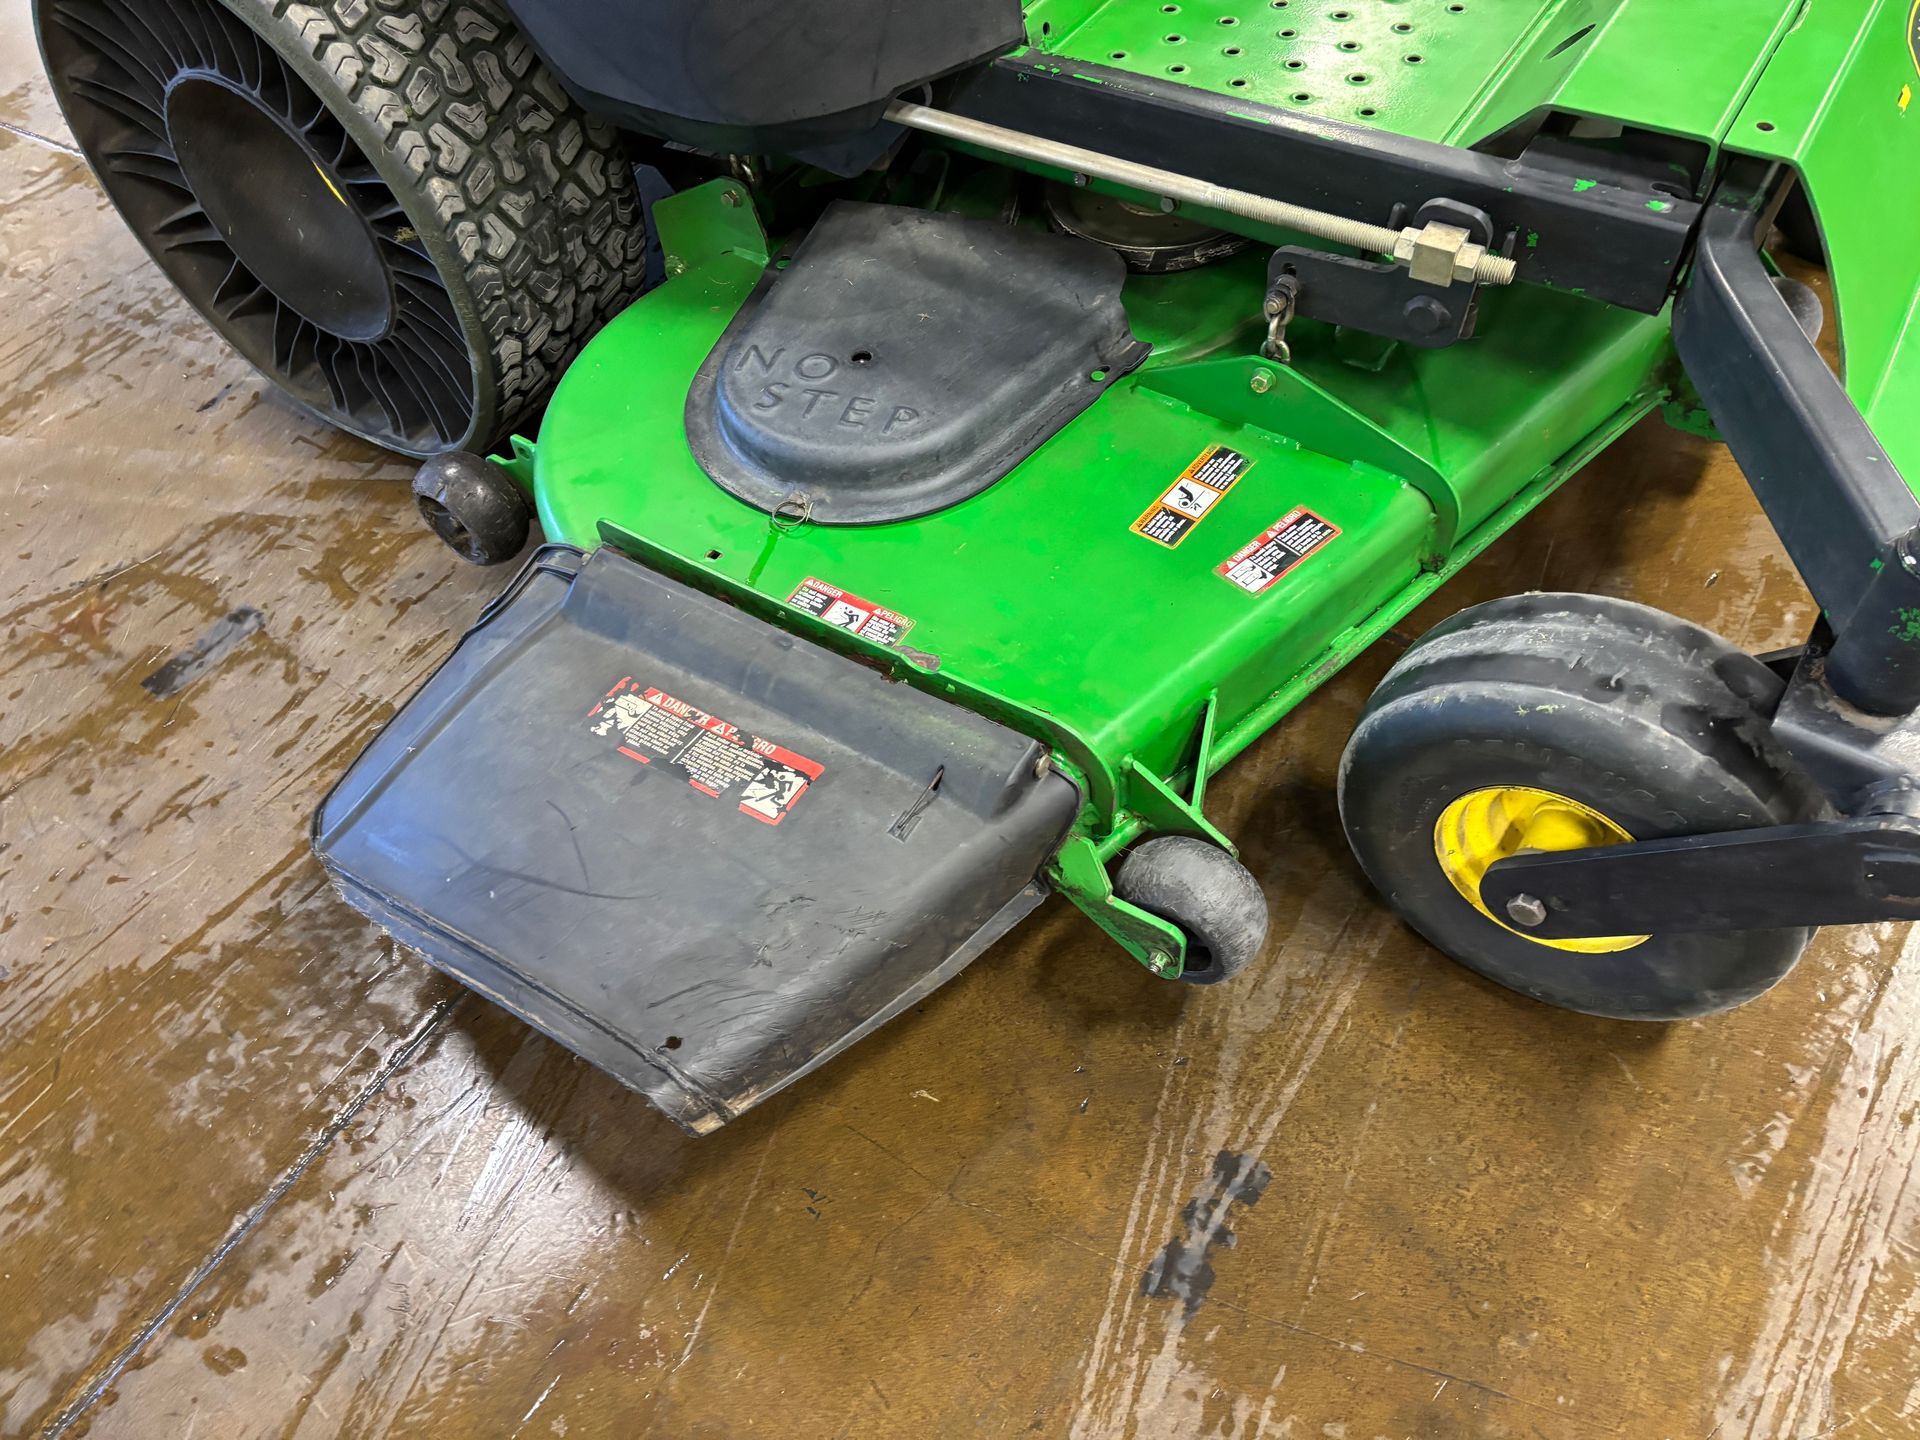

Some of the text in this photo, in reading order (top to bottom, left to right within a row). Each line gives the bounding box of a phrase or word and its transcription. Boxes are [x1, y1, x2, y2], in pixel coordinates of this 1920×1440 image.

[735, 345, 839, 380] NO
[753, 383, 920, 434] STEP
[1274, 511, 1301, 532] PELIGRO
[1234, 541, 1261, 561] DANGER
[813, 581, 843, 598] DANGER
[880, 609, 913, 628] PELIGRO
